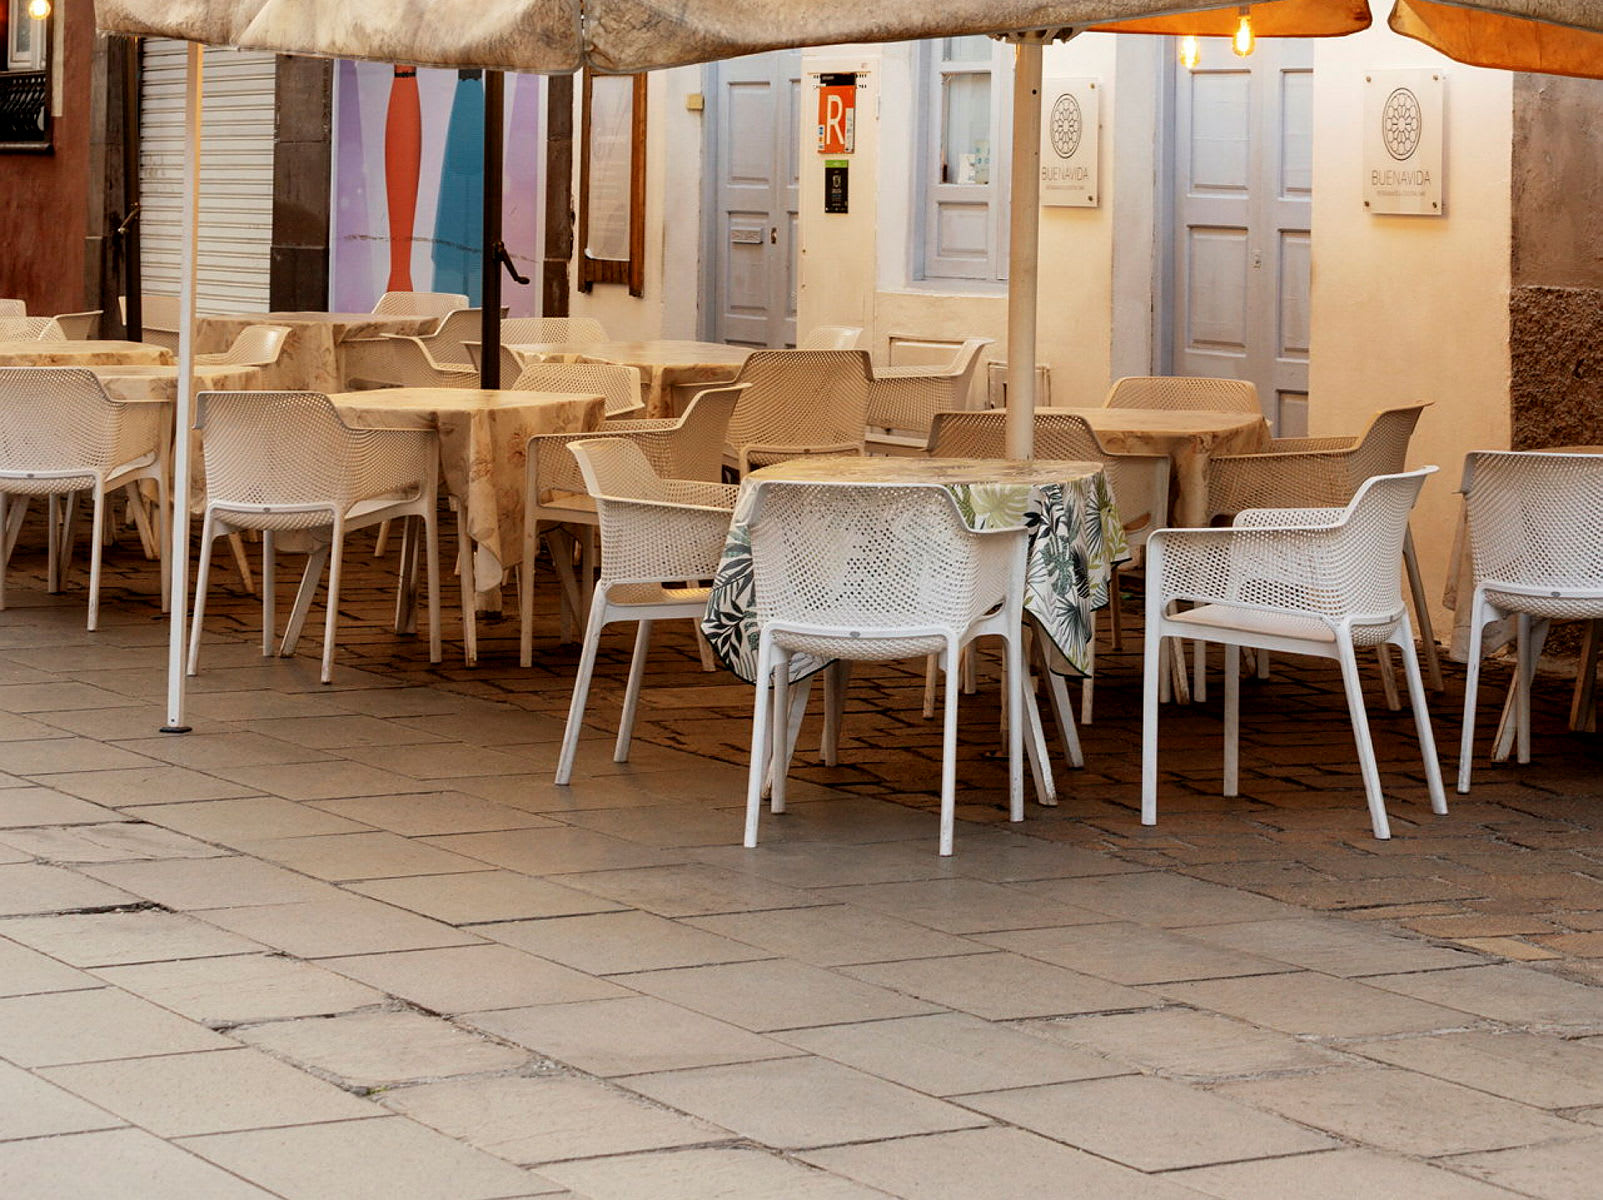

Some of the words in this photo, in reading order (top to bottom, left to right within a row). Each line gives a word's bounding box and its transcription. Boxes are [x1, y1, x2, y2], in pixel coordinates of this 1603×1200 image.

[826, 94, 844, 145] R
[1041, 166, 1088, 181] BUENAVIDA
[1371, 169, 1431, 186] BUENAVIDA
